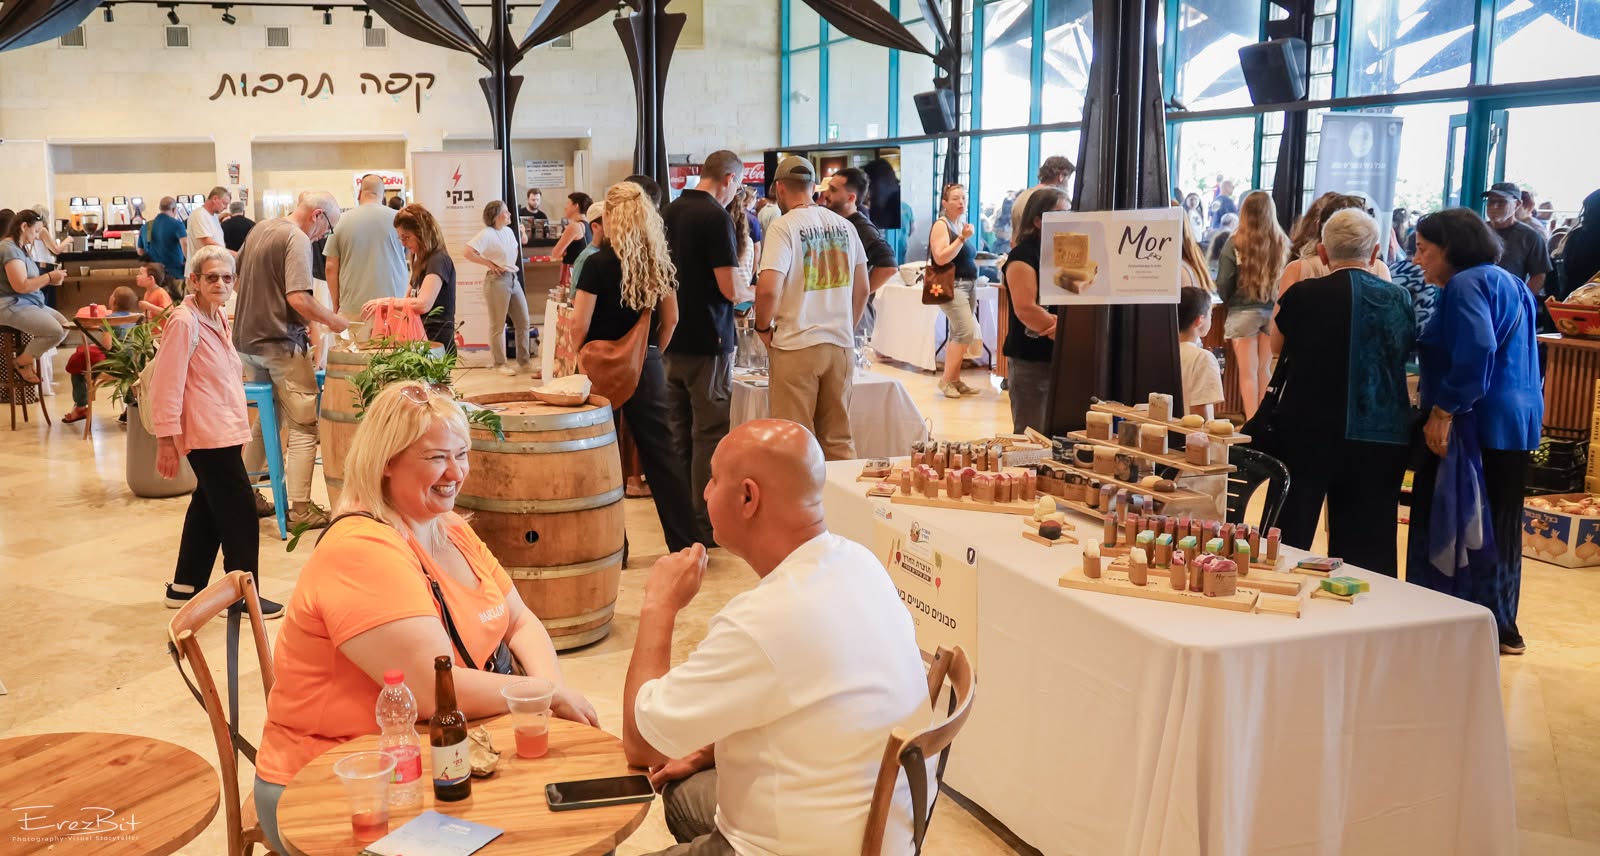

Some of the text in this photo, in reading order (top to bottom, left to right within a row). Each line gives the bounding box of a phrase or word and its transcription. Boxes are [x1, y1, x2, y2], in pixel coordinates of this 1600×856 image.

[209, 73, 435, 113] קפה תרבות
[356, 176, 403, 186] PCORN
[446, 190, 474, 204] בקי
[1118, 225, 1172, 259] Mor
[907, 594, 930, 615] טבעיים
[931, 609, 957, 629] סבונים
